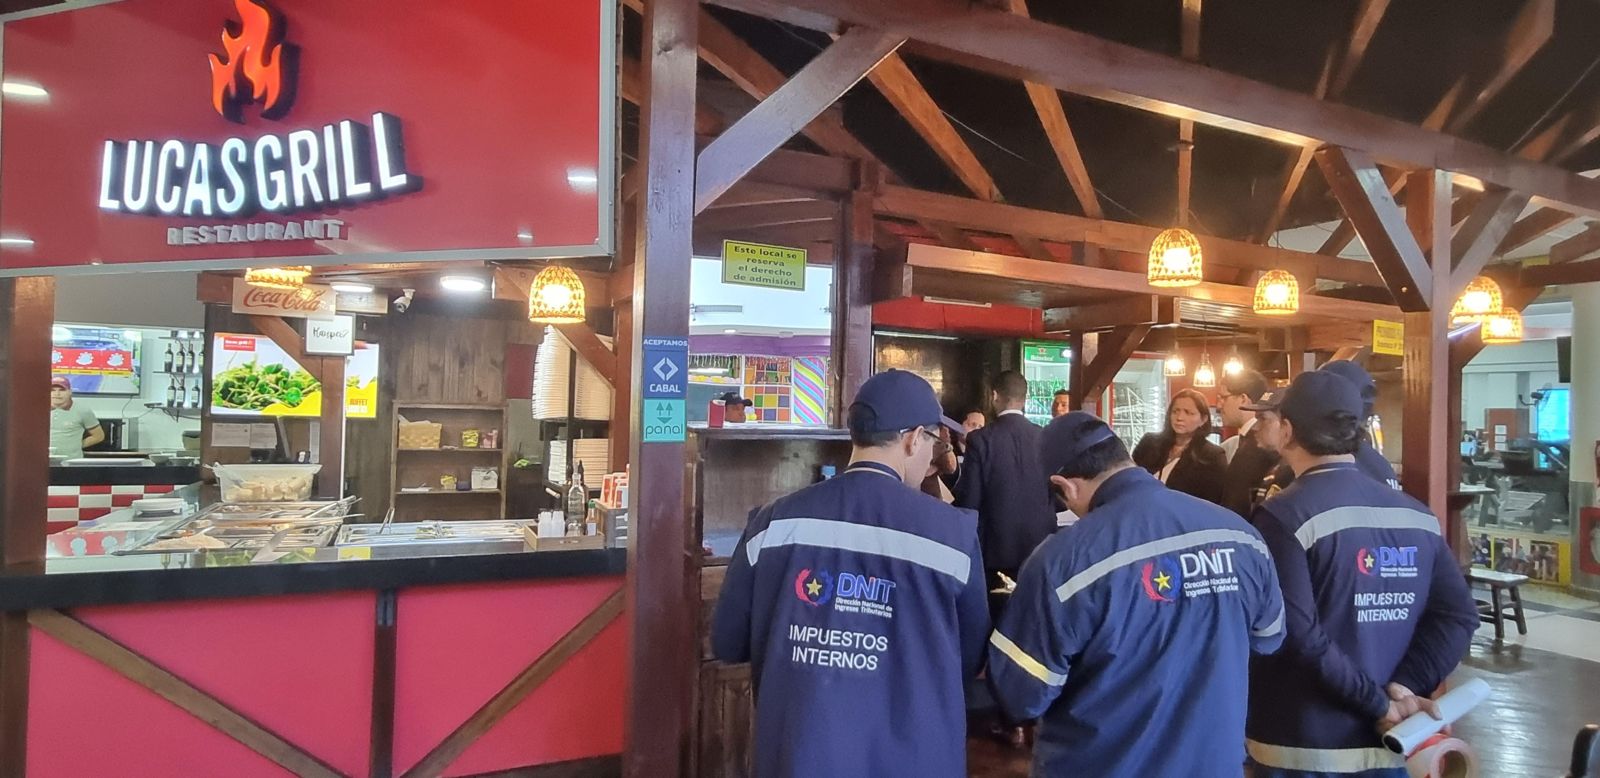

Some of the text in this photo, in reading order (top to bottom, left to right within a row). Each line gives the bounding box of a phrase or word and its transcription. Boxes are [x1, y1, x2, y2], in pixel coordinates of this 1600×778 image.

[167, 219, 345, 245] RESTAURANT
[734, 246, 756, 255] Este
[759, 248, 783, 258] local
[746, 257, 785, 267] reserva
[751, 266, 792, 277] derecho
[733, 273, 796, 286] de admisión
[643, 338, 688, 347] ACEPTAMOS
[649, 384, 681, 393] CABAL
[645, 423, 684, 439] panal
[1180, 547, 1235, 578] DNIT
[1379, 546, 1418, 567] DNIT
[836, 572, 897, 604] DNIT
[1354, 592, 1416, 607] IMPUESTOS
[860, 606, 893, 618] Tributarios
[1357, 608, 1410, 622] INTERNOS
[789, 624, 888, 651] IMPUESTOS
[792, 646, 878, 671] INTERNOS
